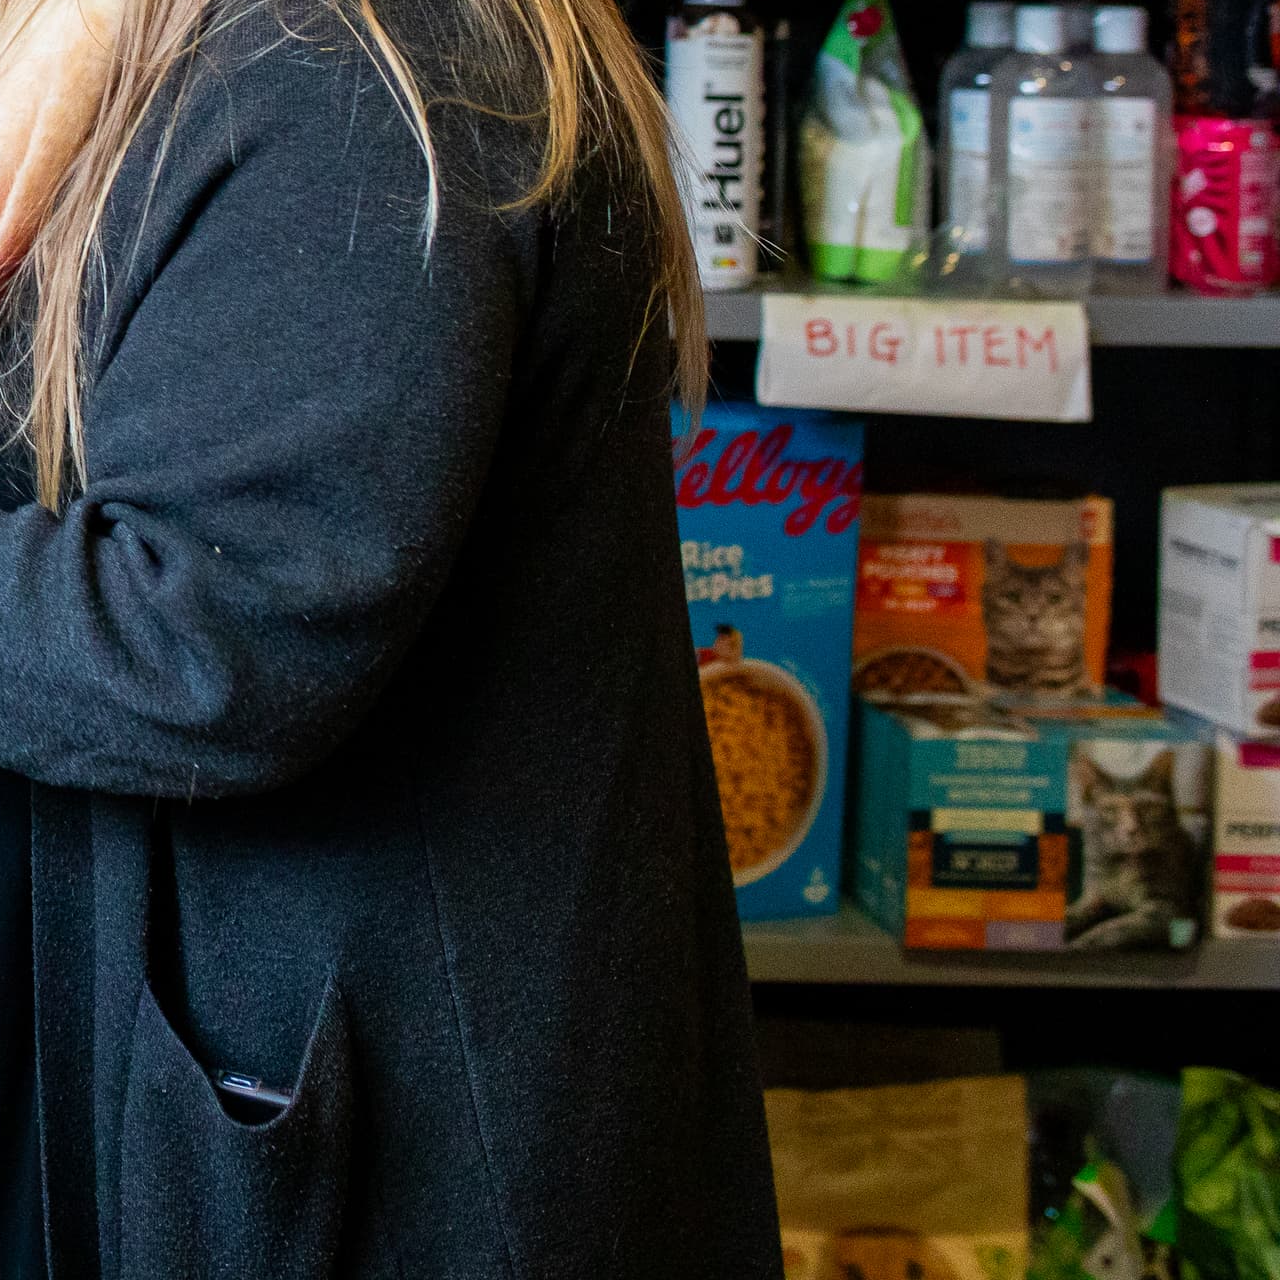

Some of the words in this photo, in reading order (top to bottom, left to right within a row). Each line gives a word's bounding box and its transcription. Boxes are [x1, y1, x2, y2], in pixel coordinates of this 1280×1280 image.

[702, 94, 746, 210] Huel
[804, 317, 902, 365] BIG
[933, 325, 1059, 373] ITEM
